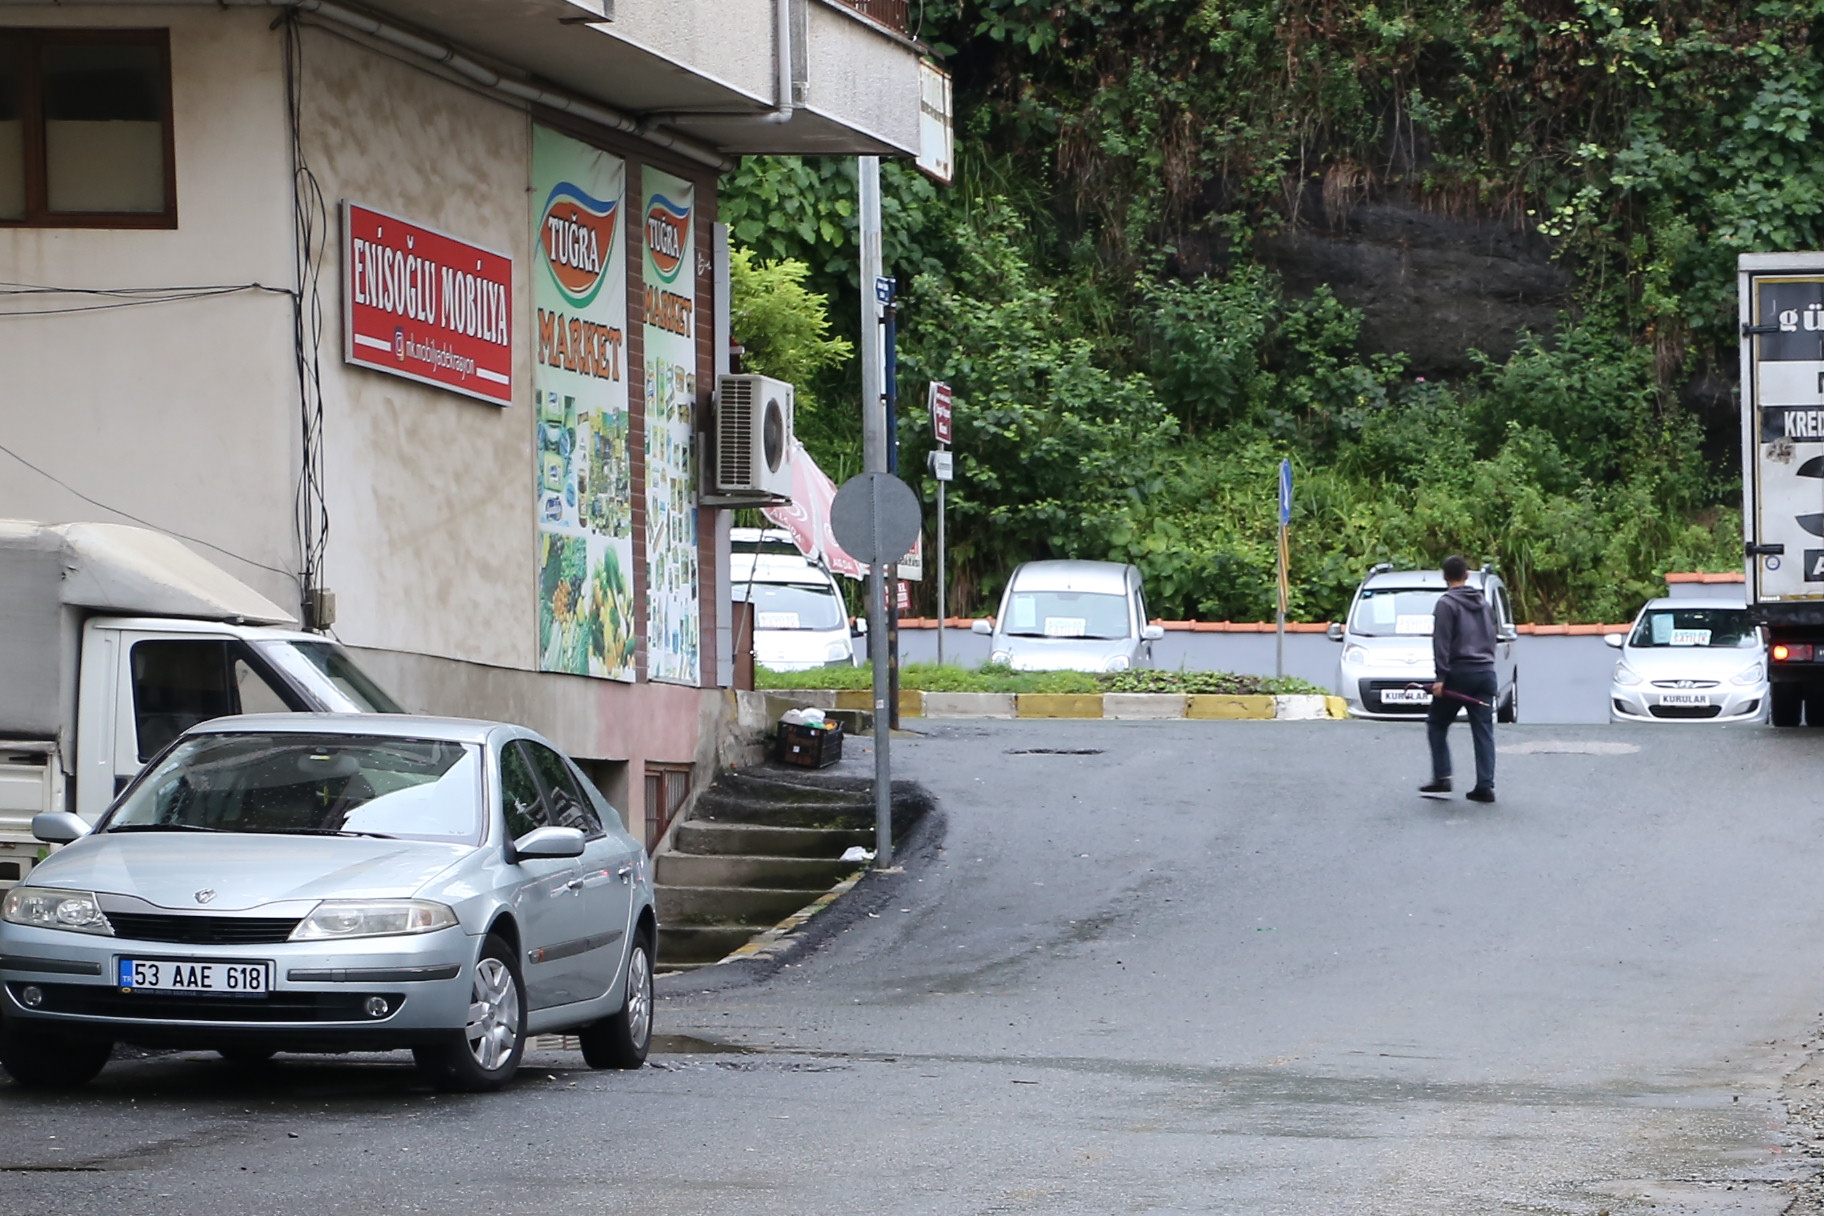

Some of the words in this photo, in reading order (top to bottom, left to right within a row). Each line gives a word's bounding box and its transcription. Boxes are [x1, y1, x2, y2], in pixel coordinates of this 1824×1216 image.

[548, 212, 600, 274] TUĞRA
[648, 215, 680, 259] TUĞRA
[354, 226, 436, 325] ENİSOĞLU
[440, 259, 508, 347] MOBİLYA
[643, 283, 692, 338] MARKET
[538, 308, 622, 382] MARKET
[1663, 695, 1706, 704] KURULAR
[135, 963, 159, 987] 53
[173, 965, 212, 988] AAE
[227, 967, 261, 990] 618
